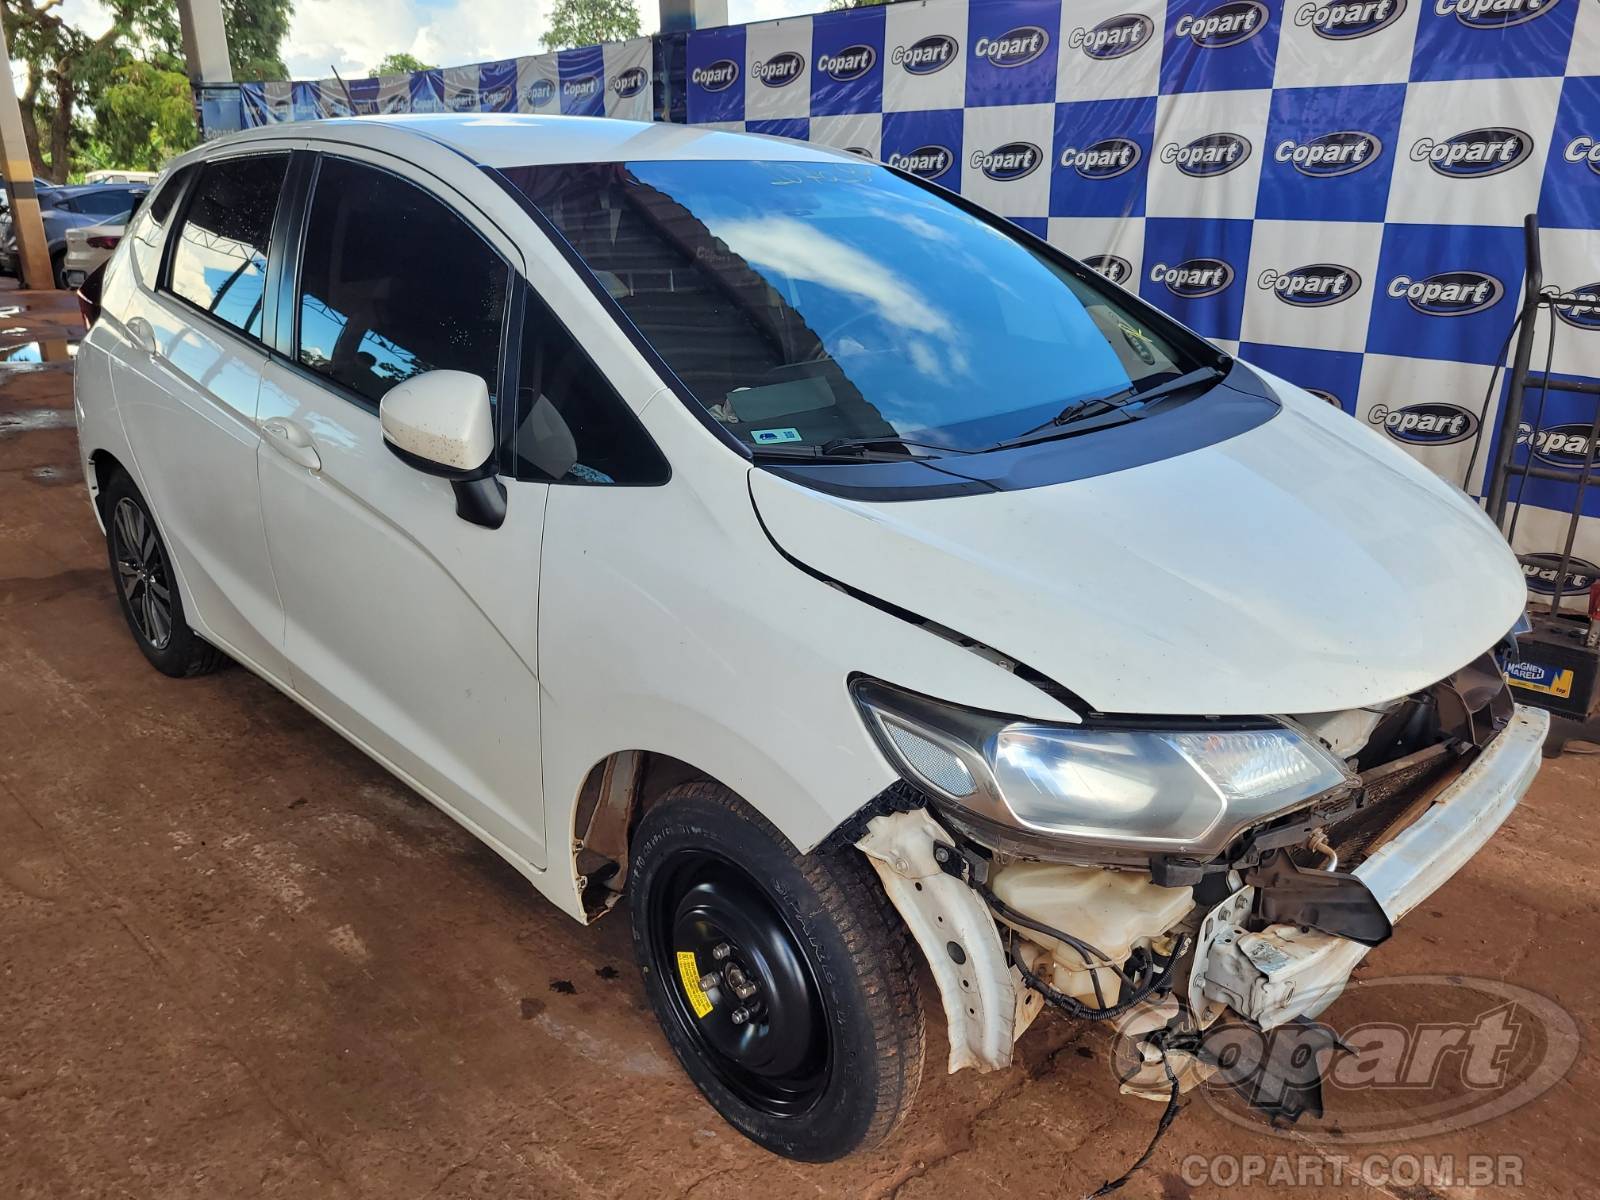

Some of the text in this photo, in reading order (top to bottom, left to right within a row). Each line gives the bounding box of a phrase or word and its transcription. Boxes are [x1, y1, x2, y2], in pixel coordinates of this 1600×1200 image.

[1175, 6, 1256, 39] Copart
[1294, 0, 1391, 31] Copart
[975, 32, 1044, 61] Copart
[1068, 20, 1142, 53] Copart
[752, 58, 800, 81] Copart
[818, 52, 869, 75] Copart
[892, 45, 948, 70] Copart
[563, 80, 595, 97] Copart
[692, 65, 734, 84] Copart
[888, 151, 945, 173] Copart
[970, 147, 1033, 176] Copart
[1061, 144, 1131, 174] Copart
[1160, 139, 1240, 168] Copart
[1274, 137, 1371, 170] Copart
[1409, 134, 1520, 172] Copart
[1150, 262, 1224, 290] Copart
[1257, 268, 1349, 297] Copart
[1387, 275, 1489, 307] Copart
[1367, 403, 1464, 435] Copart
[1515, 421, 1600, 455] Copa
